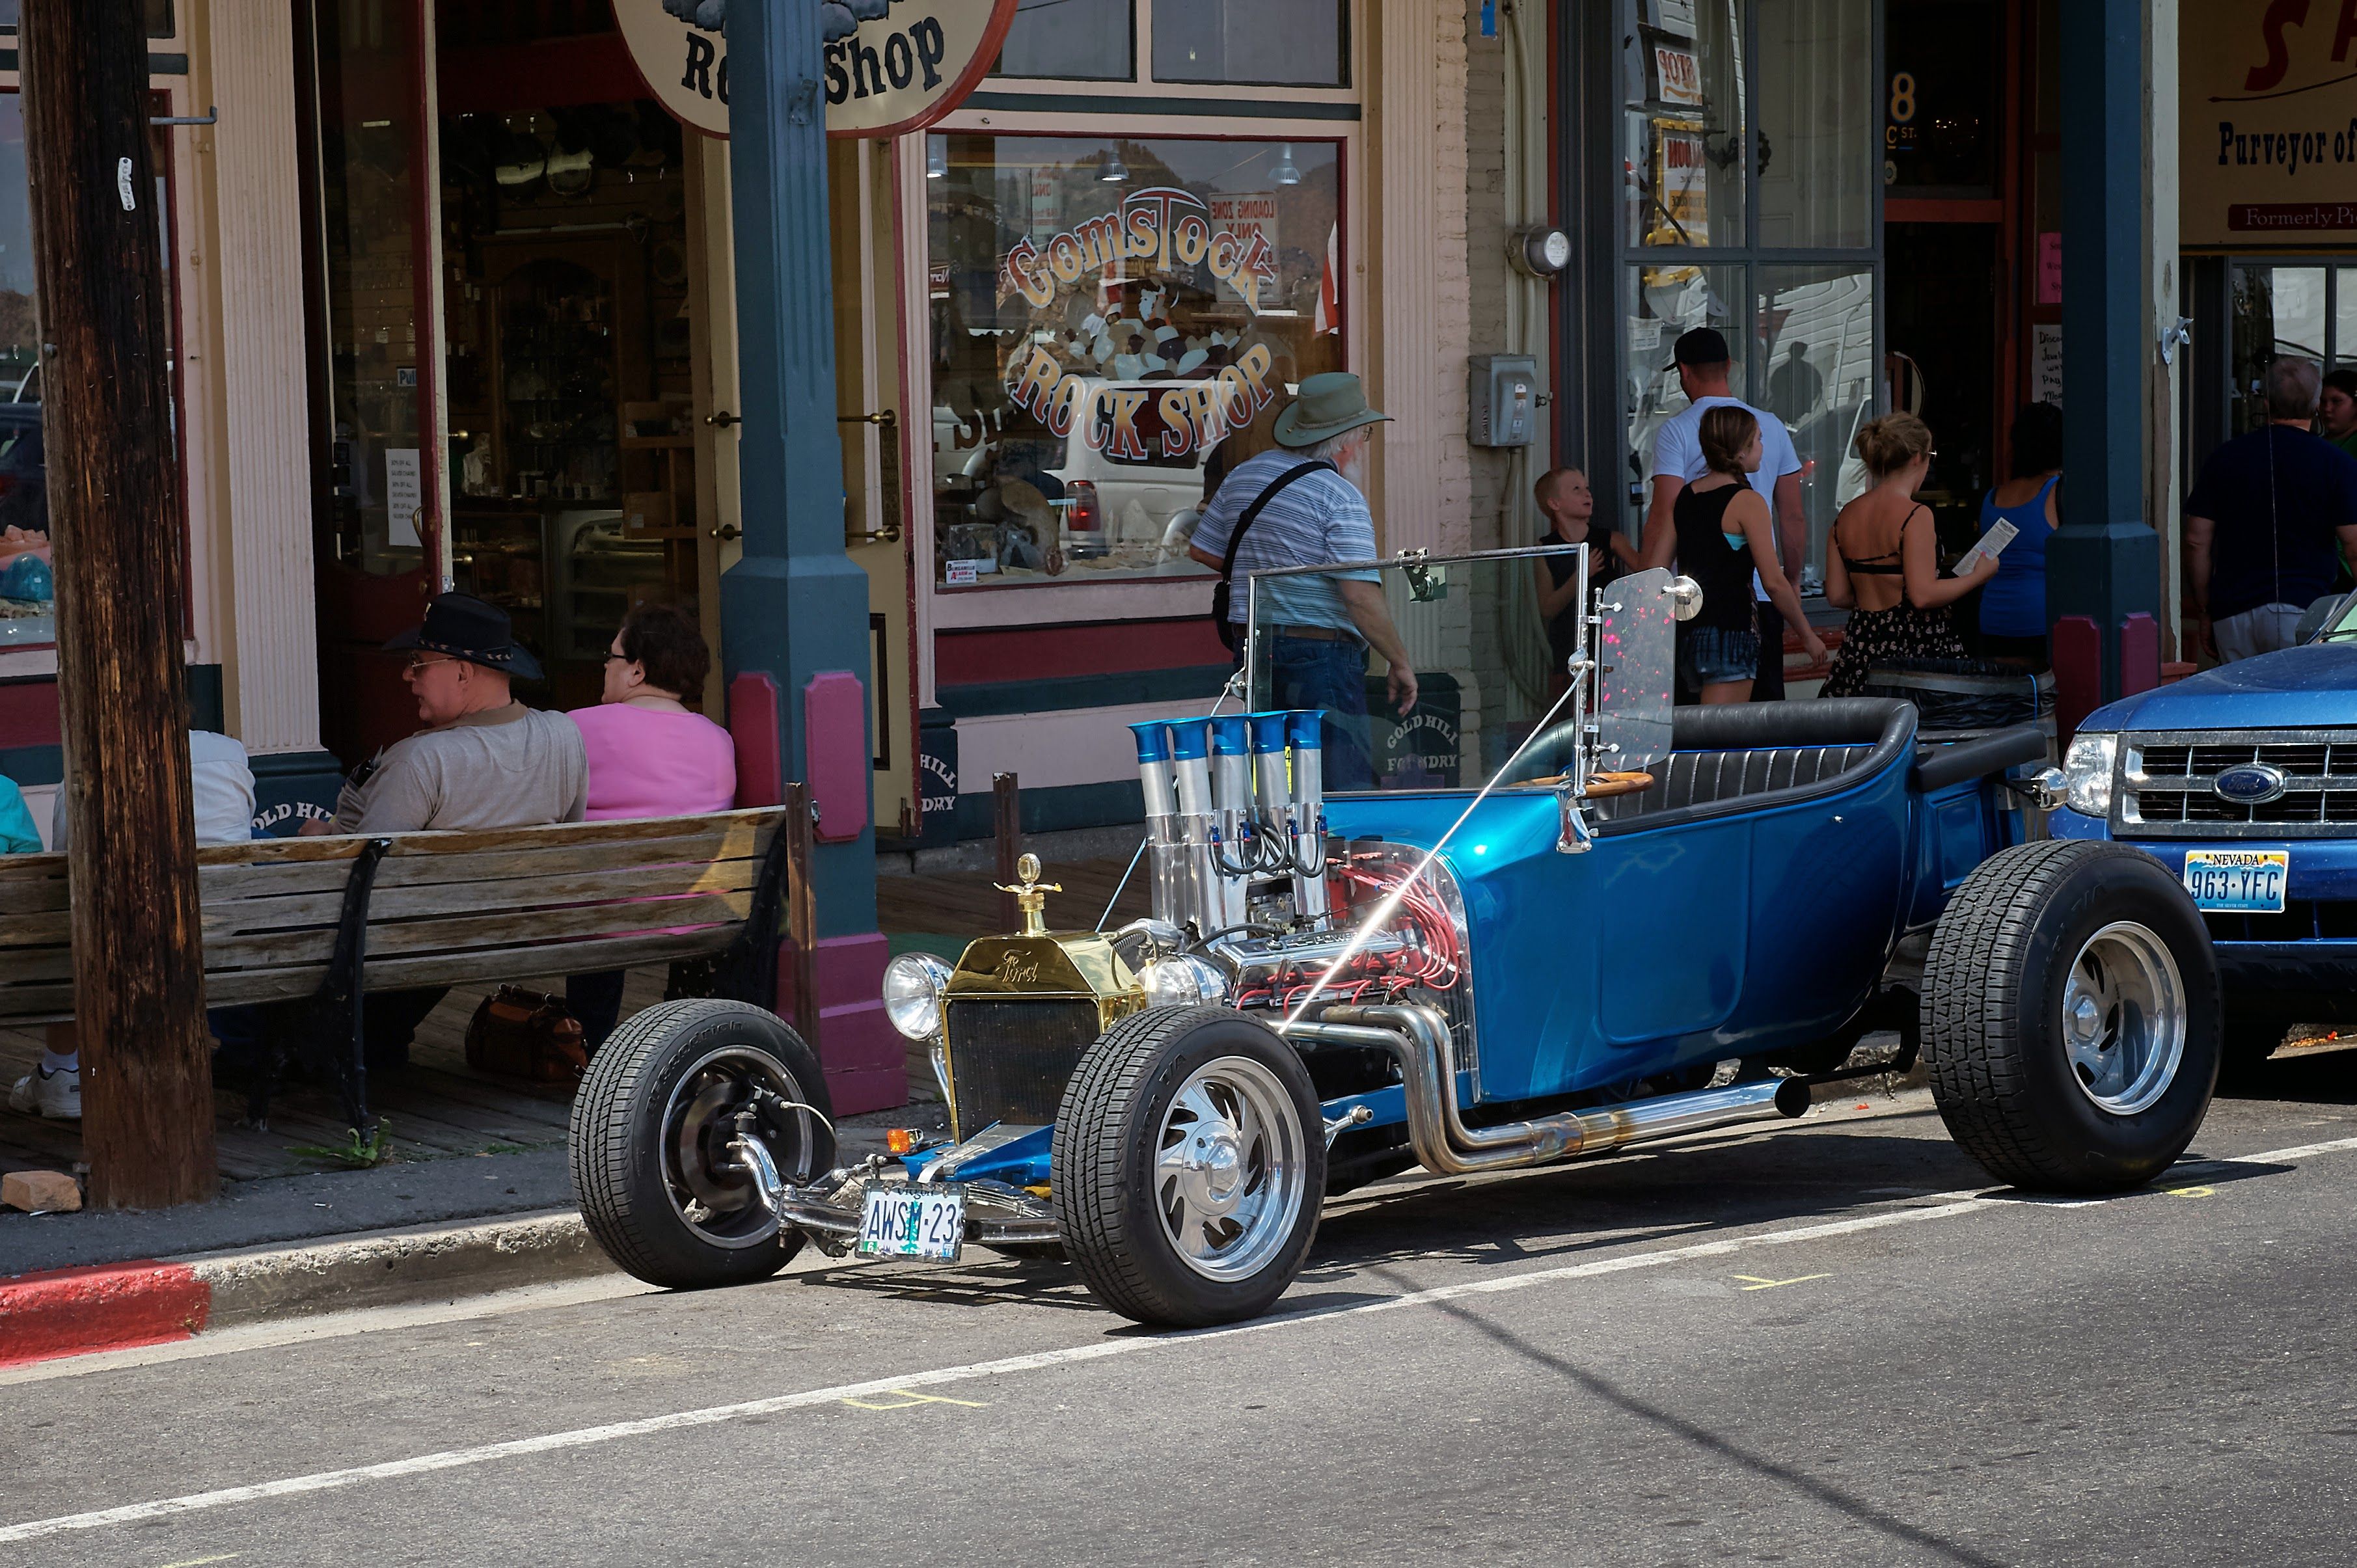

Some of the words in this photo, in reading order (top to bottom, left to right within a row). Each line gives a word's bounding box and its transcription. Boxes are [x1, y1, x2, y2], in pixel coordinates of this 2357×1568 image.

[824, 16, 944, 105] Shop
[1891, 72, 1915, 122] 8
[2218, 122, 2326, 176] Purveyor
[2246, 208, 2332, 227] Formerly
[1010, 344, 1149, 461] ROCK
[1159, 343, 1275, 457] SHOP
[1387, 714, 1423, 749] GOLD
[1425, 714, 1458, 746] HILL
[920, 754, 957, 789] HILL
[251, 804, 292, 830] OLD
[296, 802, 333, 820] HI
[2213, 854, 2259, 865] NEVADA
[867, 1200, 957, 1243] AWSM-23
